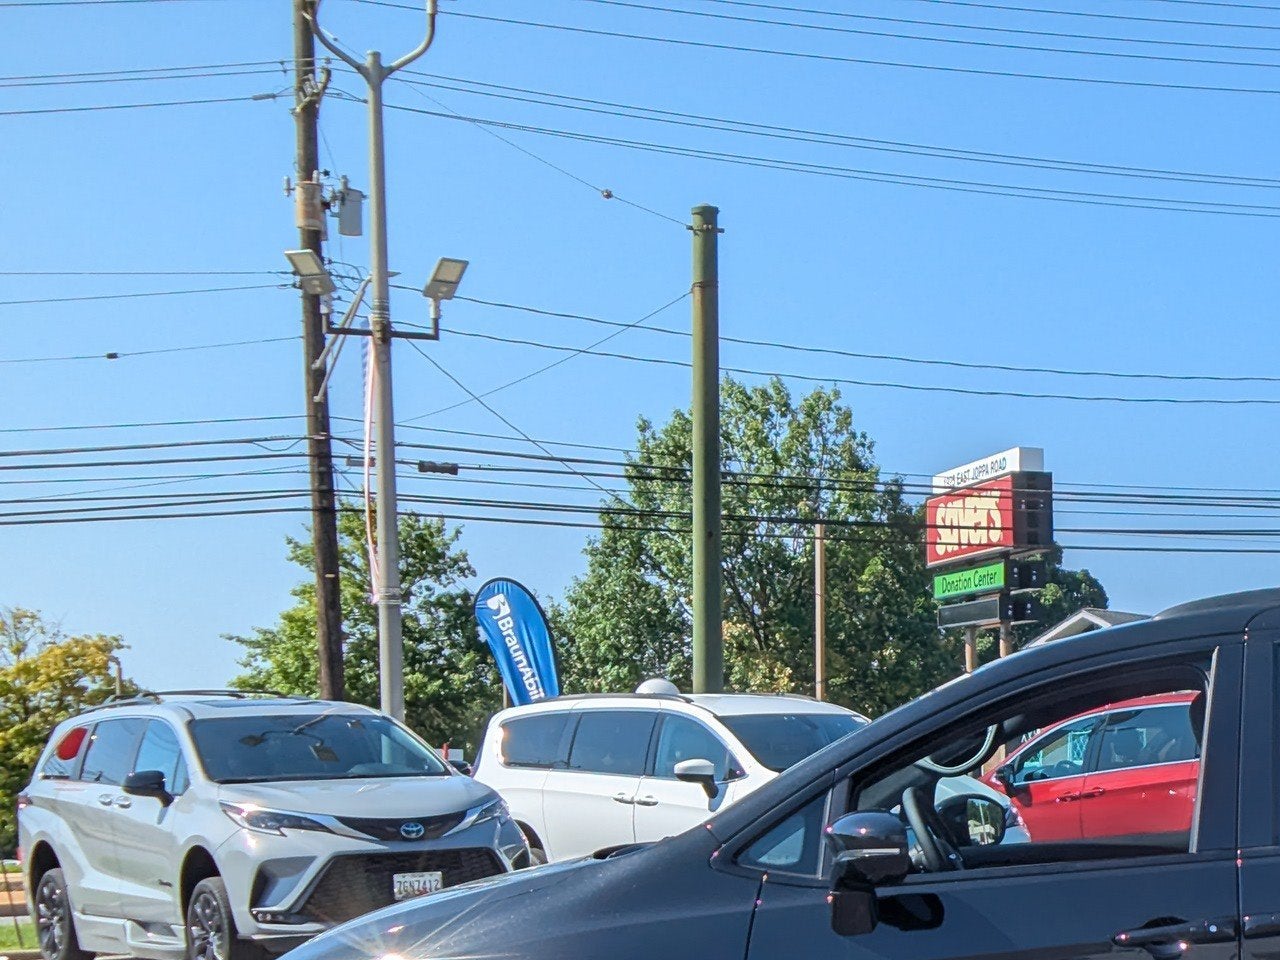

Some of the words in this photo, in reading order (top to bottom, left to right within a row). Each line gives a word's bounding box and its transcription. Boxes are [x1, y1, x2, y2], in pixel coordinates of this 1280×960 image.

[956, 469, 970, 485] EAST
[971, 464, 989, 480] JOPPA
[990, 457, 1007, 474] ROAD
[942, 573, 972, 593] Donation
[974, 570, 997, 587] Center
[497, 615, 545, 702] BraunAbil
